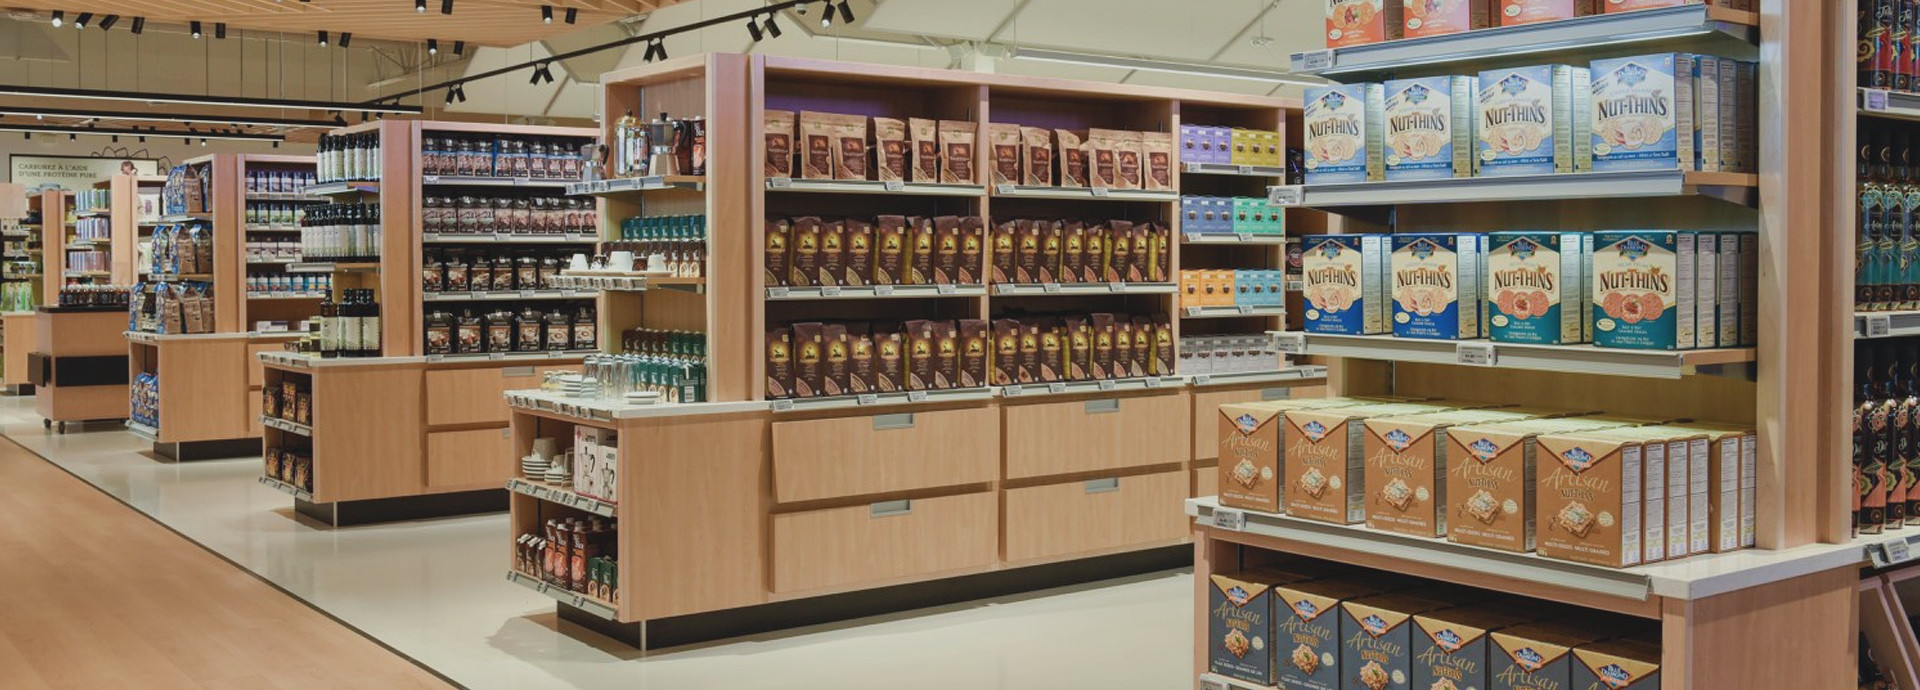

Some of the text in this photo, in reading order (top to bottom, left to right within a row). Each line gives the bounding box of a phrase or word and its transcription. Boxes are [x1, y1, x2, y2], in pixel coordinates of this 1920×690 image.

[1222, 431, 1270, 450] Artisan
[1289, 438, 1338, 460] Artisan
[1368, 447, 1426, 470] Artisan
[1451, 457, 1514, 481] Artisan
[1541, 467, 1610, 493] Artisan
[1213, 601, 1262, 625] Artisan
[1280, 616, 1331, 640] Artisan
[1346, 631, 1403, 657] Artisan
[1416, 646, 1477, 674] Artisan
